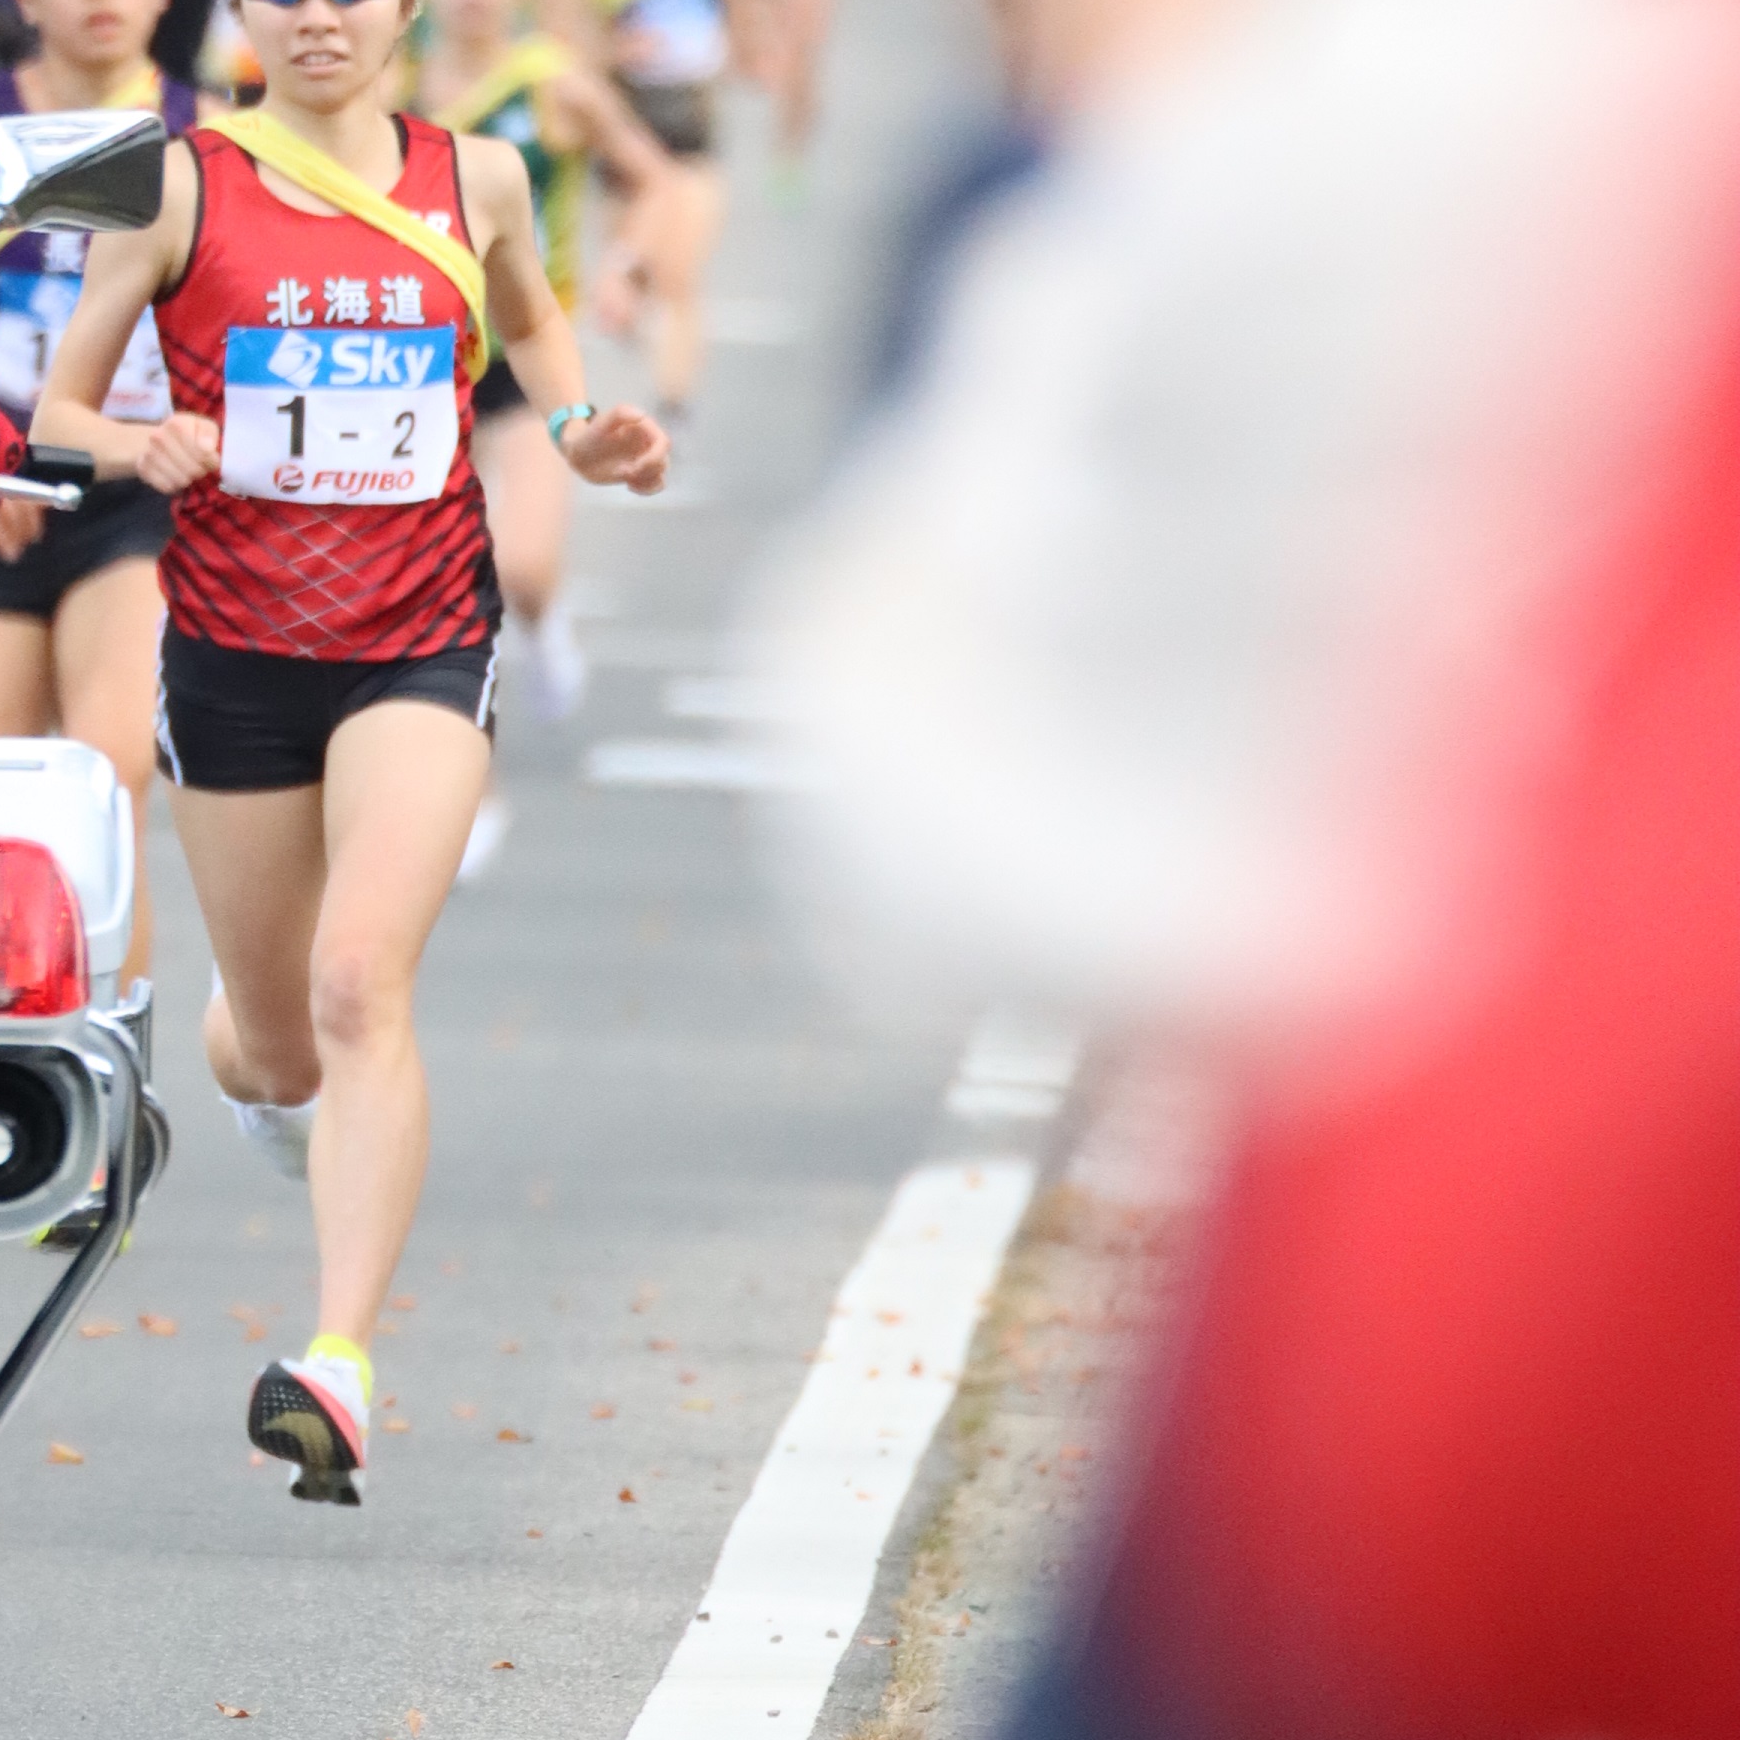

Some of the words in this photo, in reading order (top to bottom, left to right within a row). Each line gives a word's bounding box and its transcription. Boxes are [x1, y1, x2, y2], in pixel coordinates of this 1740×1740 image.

[265, 275, 425, 327] 北海道
[329, 333, 435, 390] Sky
[311, 468, 416, 498] FUJIBO
